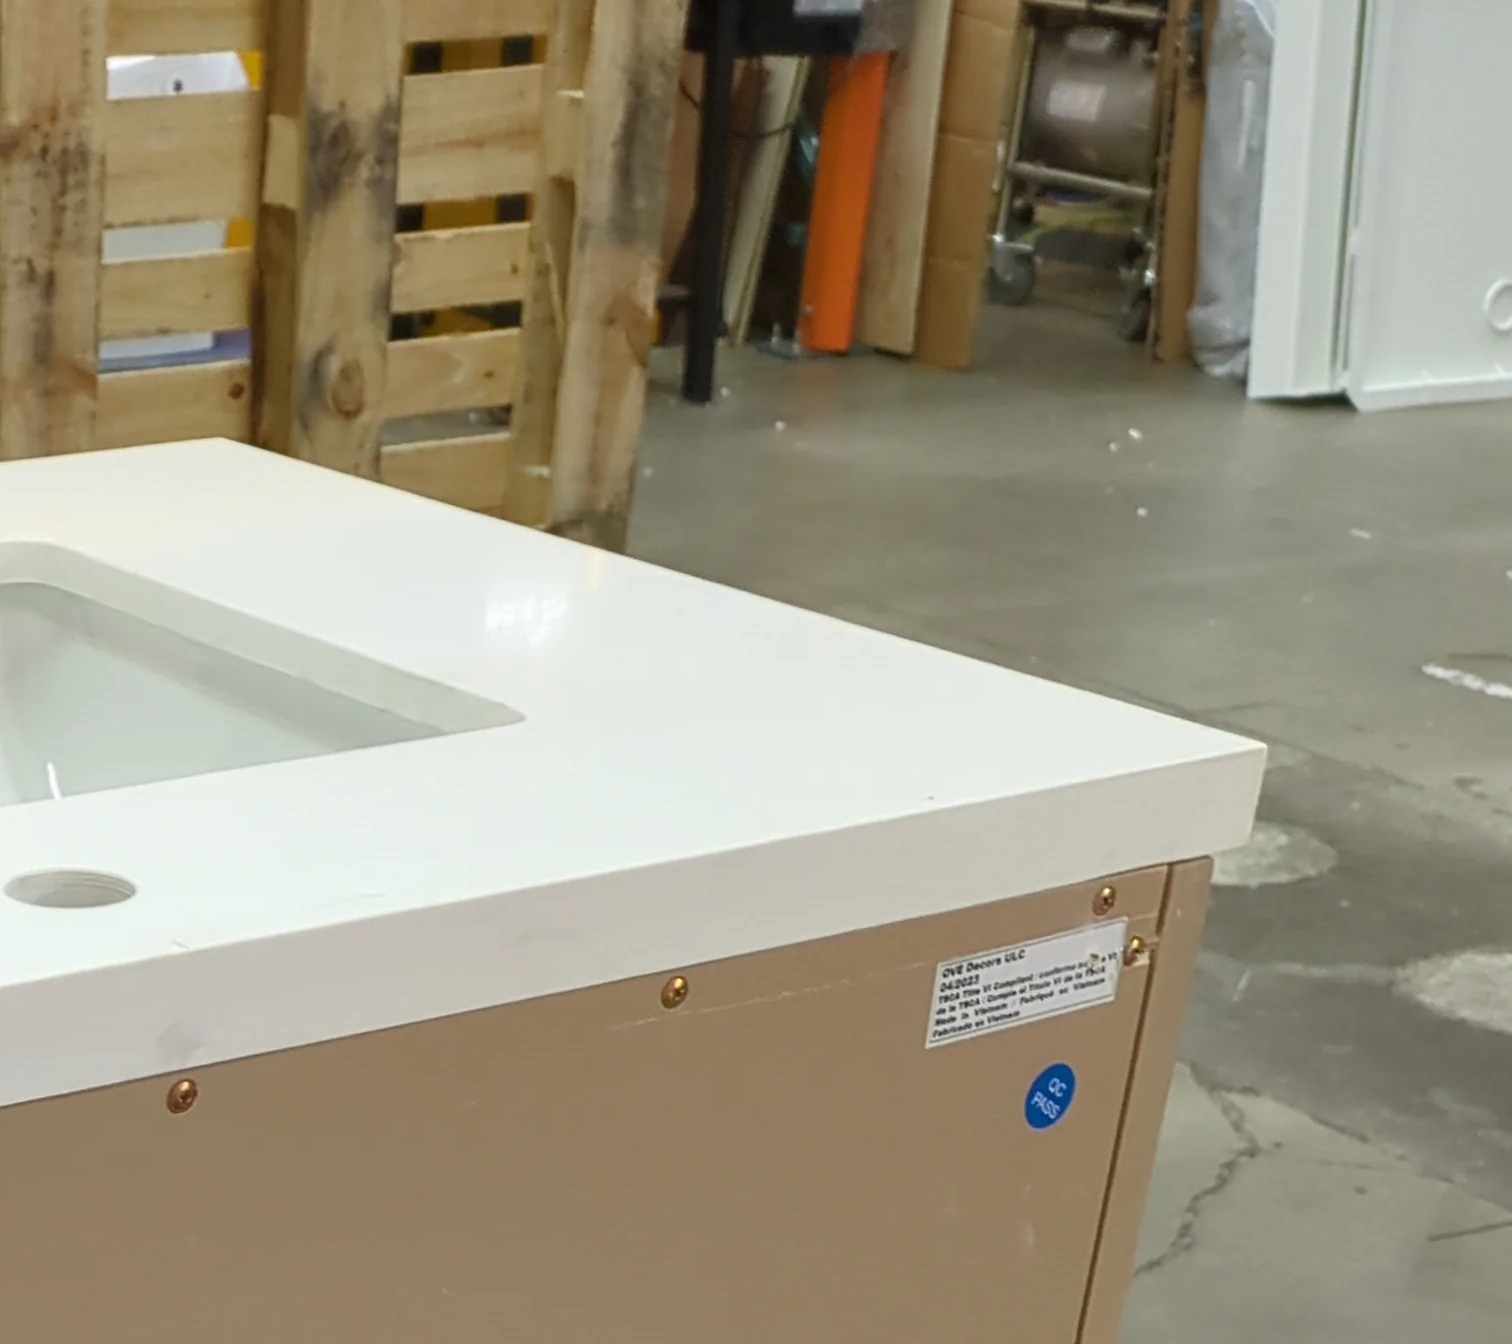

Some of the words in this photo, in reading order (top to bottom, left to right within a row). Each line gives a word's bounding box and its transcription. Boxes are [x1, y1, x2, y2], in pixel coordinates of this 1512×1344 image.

[942, 964, 963, 979] OVE
[966, 957, 1002, 973] Decors
[1004, 949, 1026, 963] ULC
[934, 1016, 957, 1027] Made
[1048, 1077, 1067, 1098] QC
[1031, 1091, 1060, 1119] PASS
